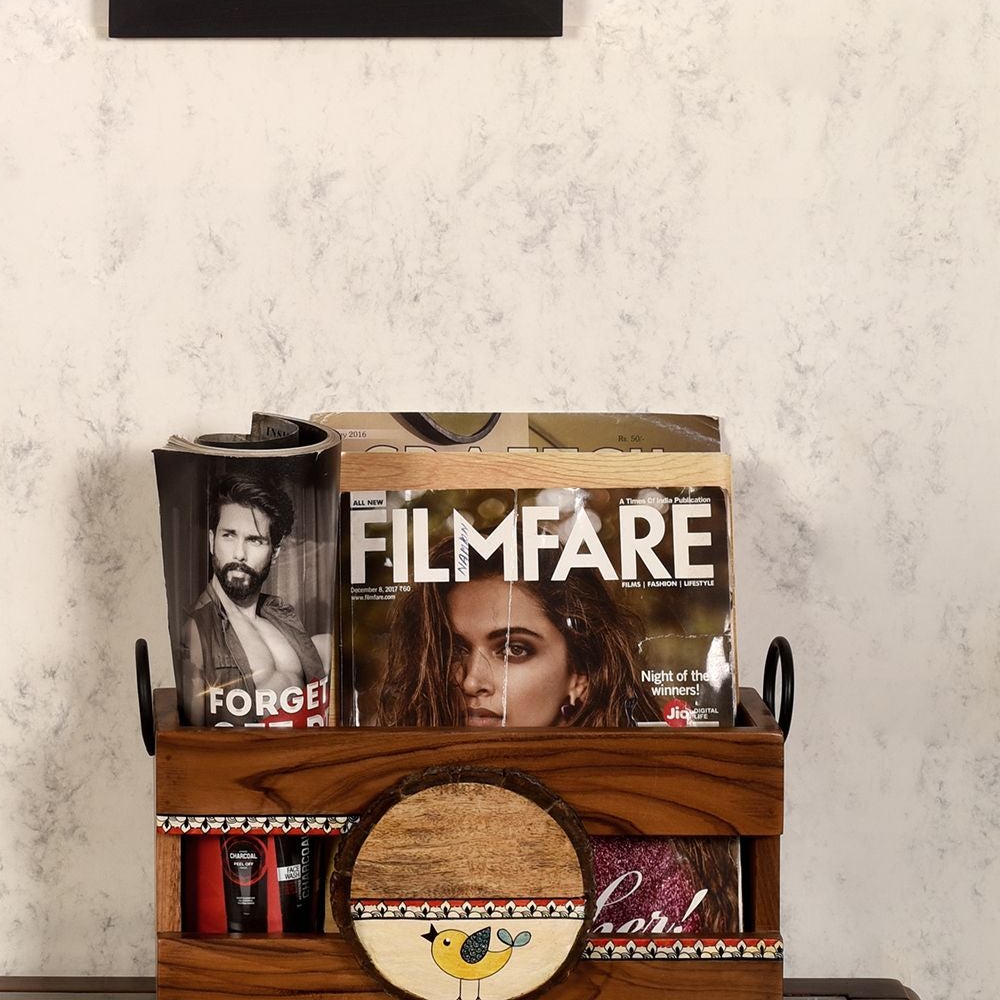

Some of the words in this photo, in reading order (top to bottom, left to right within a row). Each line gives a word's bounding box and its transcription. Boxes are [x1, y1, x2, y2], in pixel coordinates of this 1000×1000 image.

[674, 496, 711, 504] Publication
[350, 503, 715, 584] FILMFARE
[647, 580, 678, 588] FASHION
[641, 670, 673, 684] Night
[676, 669, 688, 682] of
[691, 669, 710, 682] the
[209, 675, 329, 717] FORGET
[651, 683, 700, 696] winners!
[229, 852, 258, 860] CHARCOAL
